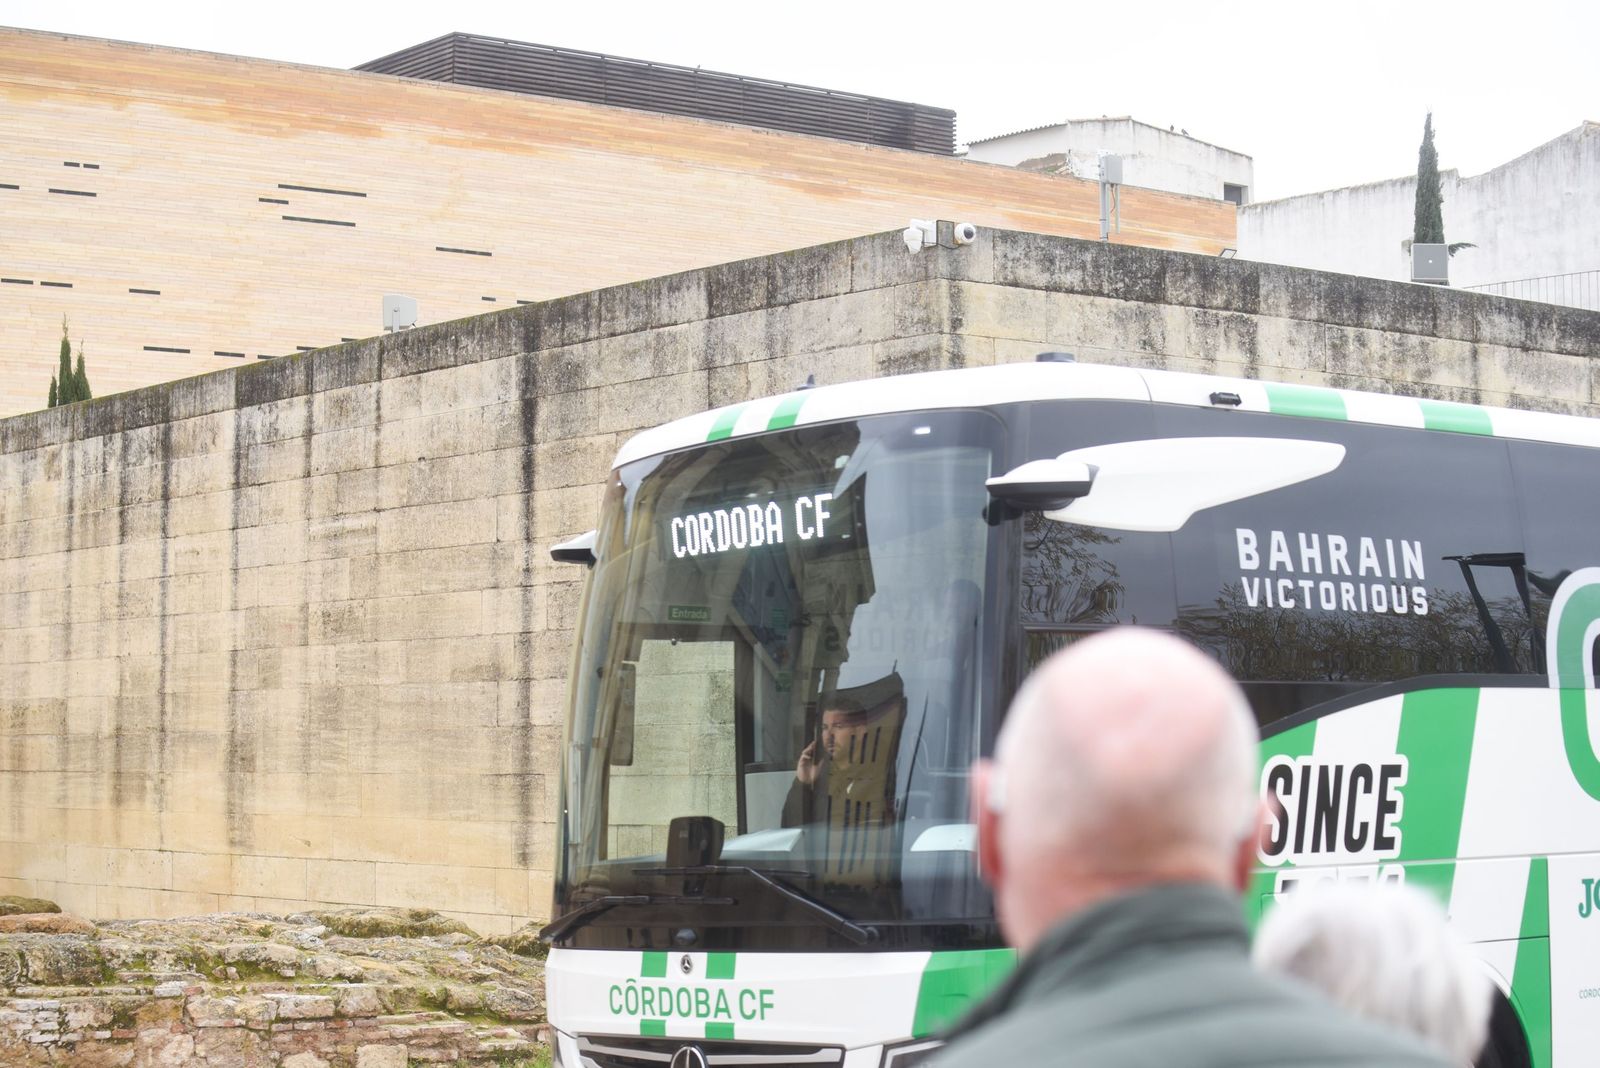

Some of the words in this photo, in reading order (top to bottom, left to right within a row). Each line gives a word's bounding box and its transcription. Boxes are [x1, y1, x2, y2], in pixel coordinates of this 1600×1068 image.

[671, 501, 784, 558] CORDOBA
[795, 493, 833, 540] CF
[1236, 528, 1425, 580] BAHRAIN
[672, 607, 708, 619] Entrada
[1241, 576, 1428, 615] VICTORIOUS
[1260, 763, 1402, 857] SINCE
[739, 988, 774, 1021] CF
